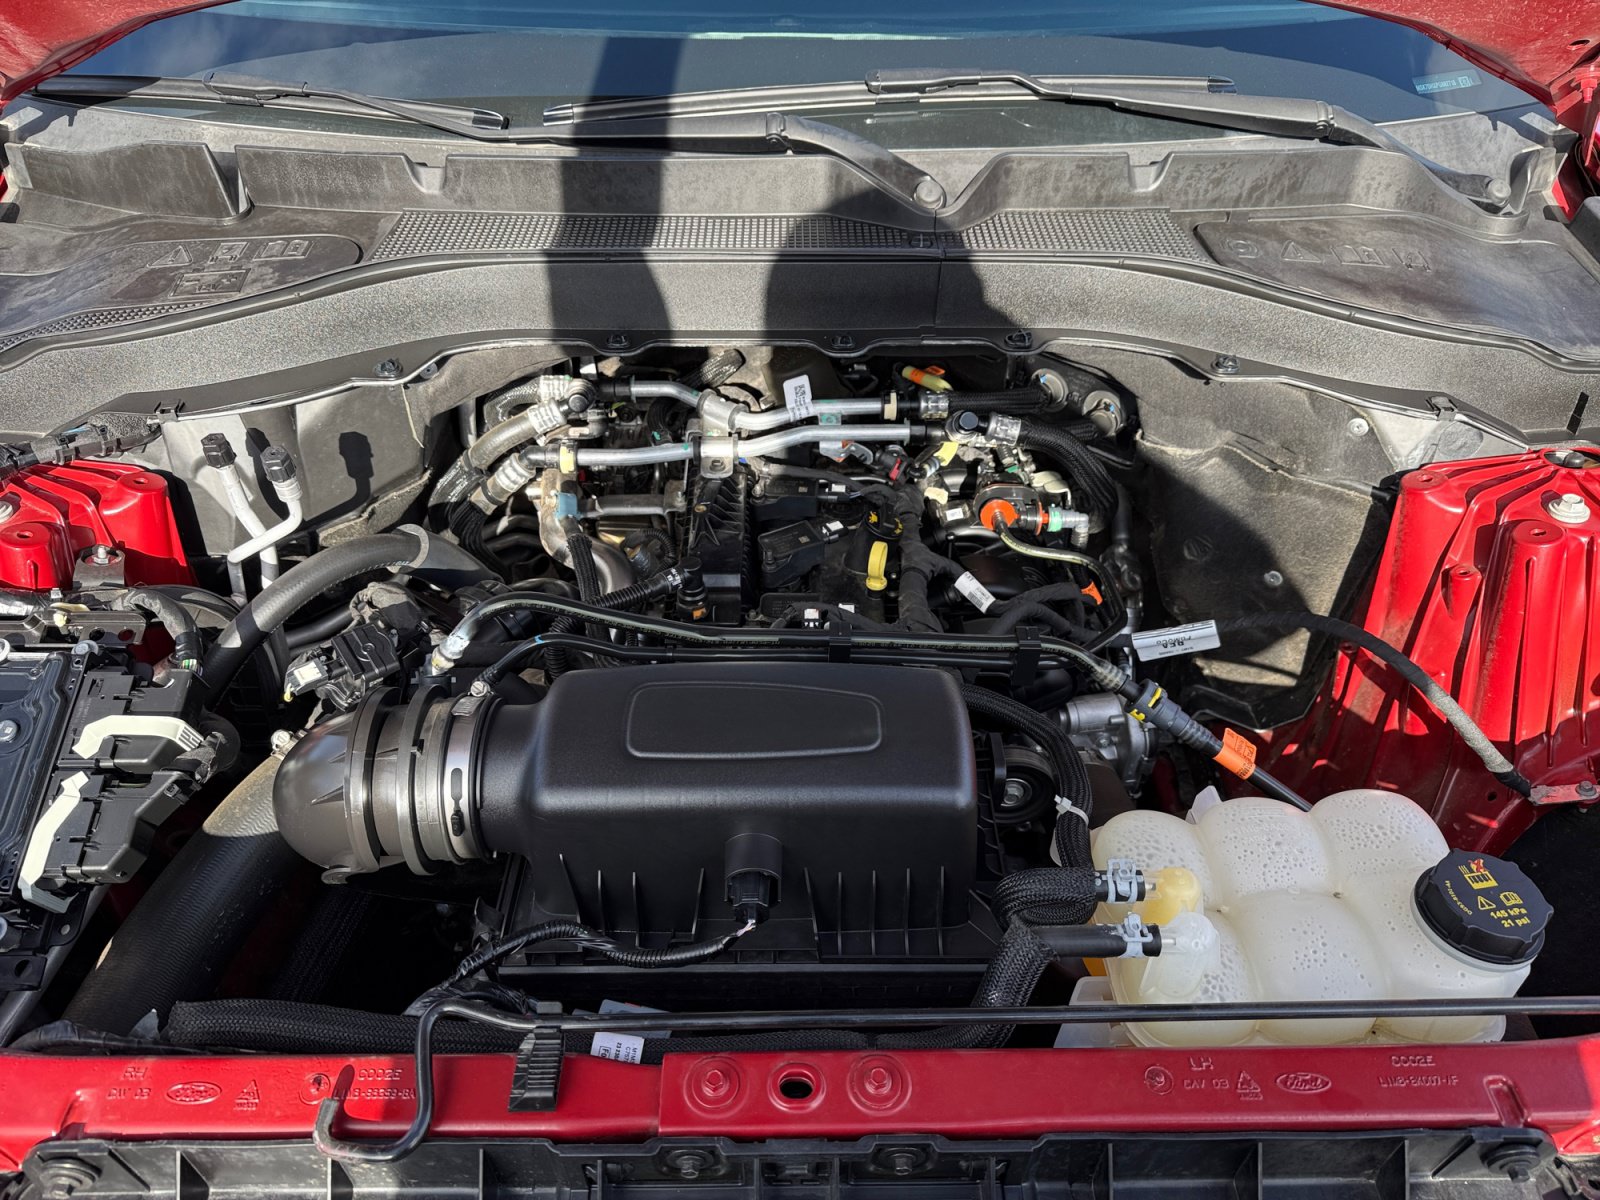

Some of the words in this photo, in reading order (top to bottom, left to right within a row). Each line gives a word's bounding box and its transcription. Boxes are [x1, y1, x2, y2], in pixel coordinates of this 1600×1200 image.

[1490, 909, 1508, 919] 145
[1507, 907, 1528, 916] kPa
[1501, 919, 1515, 928] 21
[1515, 916, 1531, 927] psi
[1283, 1073, 1323, 1091] Ford
[172, 1084, 218, 1102] Ford
